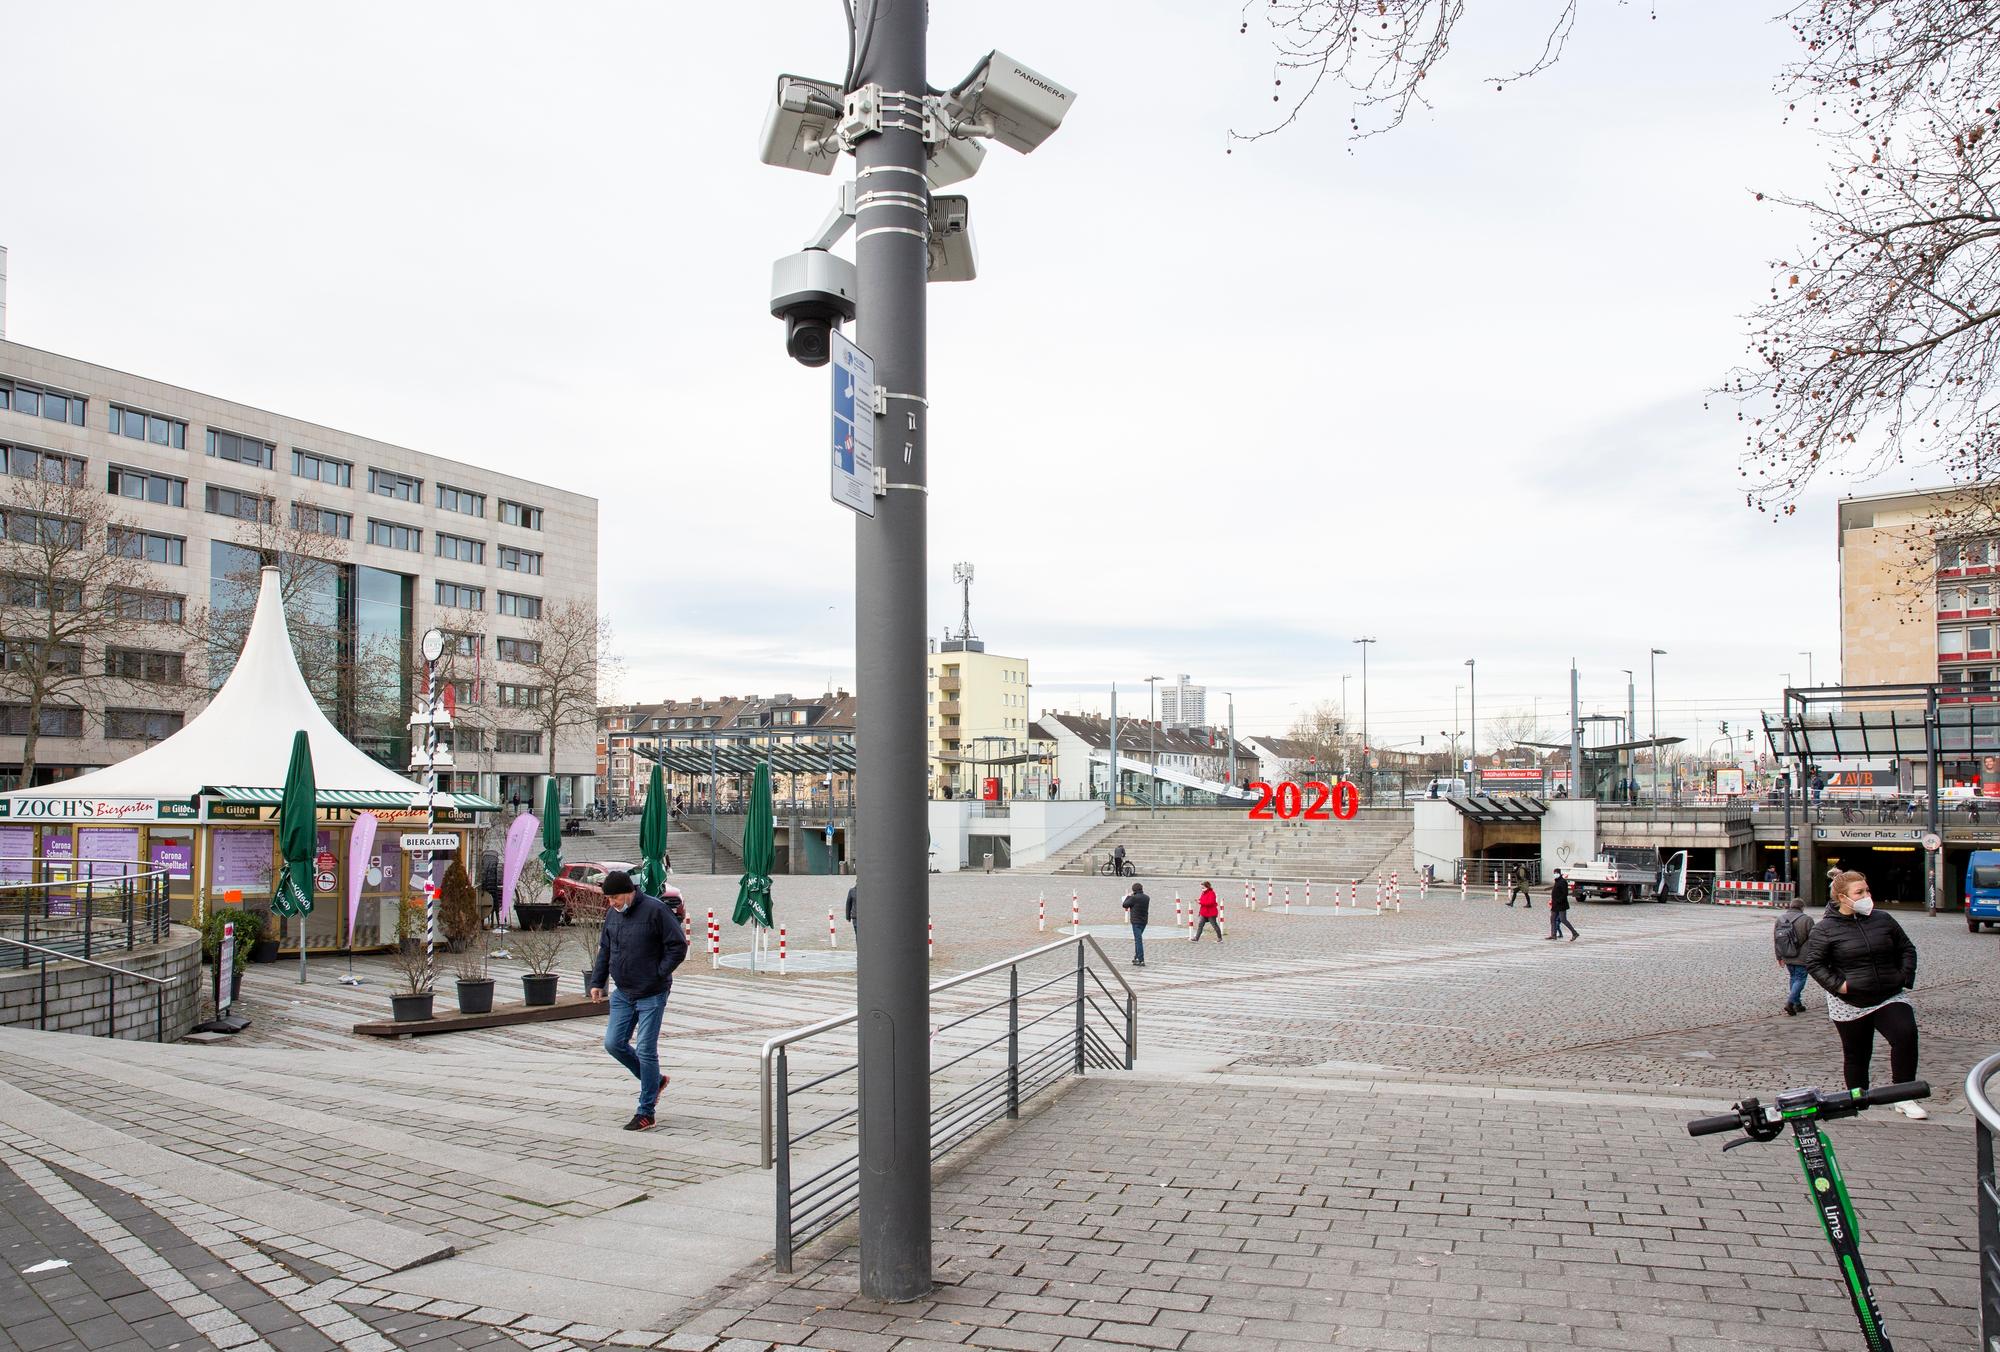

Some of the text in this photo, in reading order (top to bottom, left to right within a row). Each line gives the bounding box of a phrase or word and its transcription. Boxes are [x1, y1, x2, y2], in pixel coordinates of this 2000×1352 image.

[1013, 68, 1066, 101] PANOMERA
[1844, 772, 1873, 785] AWB
[1248, 781, 1359, 820] 2020
[96, 801, 153, 819] Biergarten
[226, 805, 255, 814] Gilden
[368, 808, 427, 822] iergarten
[1875, 831, 1896, 839] Platz
[51, 840, 71, 849] Corona
[406, 838, 456, 846] BIERGARTEN
[160, 851, 182, 860] Corona
[1800, 1137, 1818, 1145] Lime
[1824, 1205, 1844, 1239] Lime
